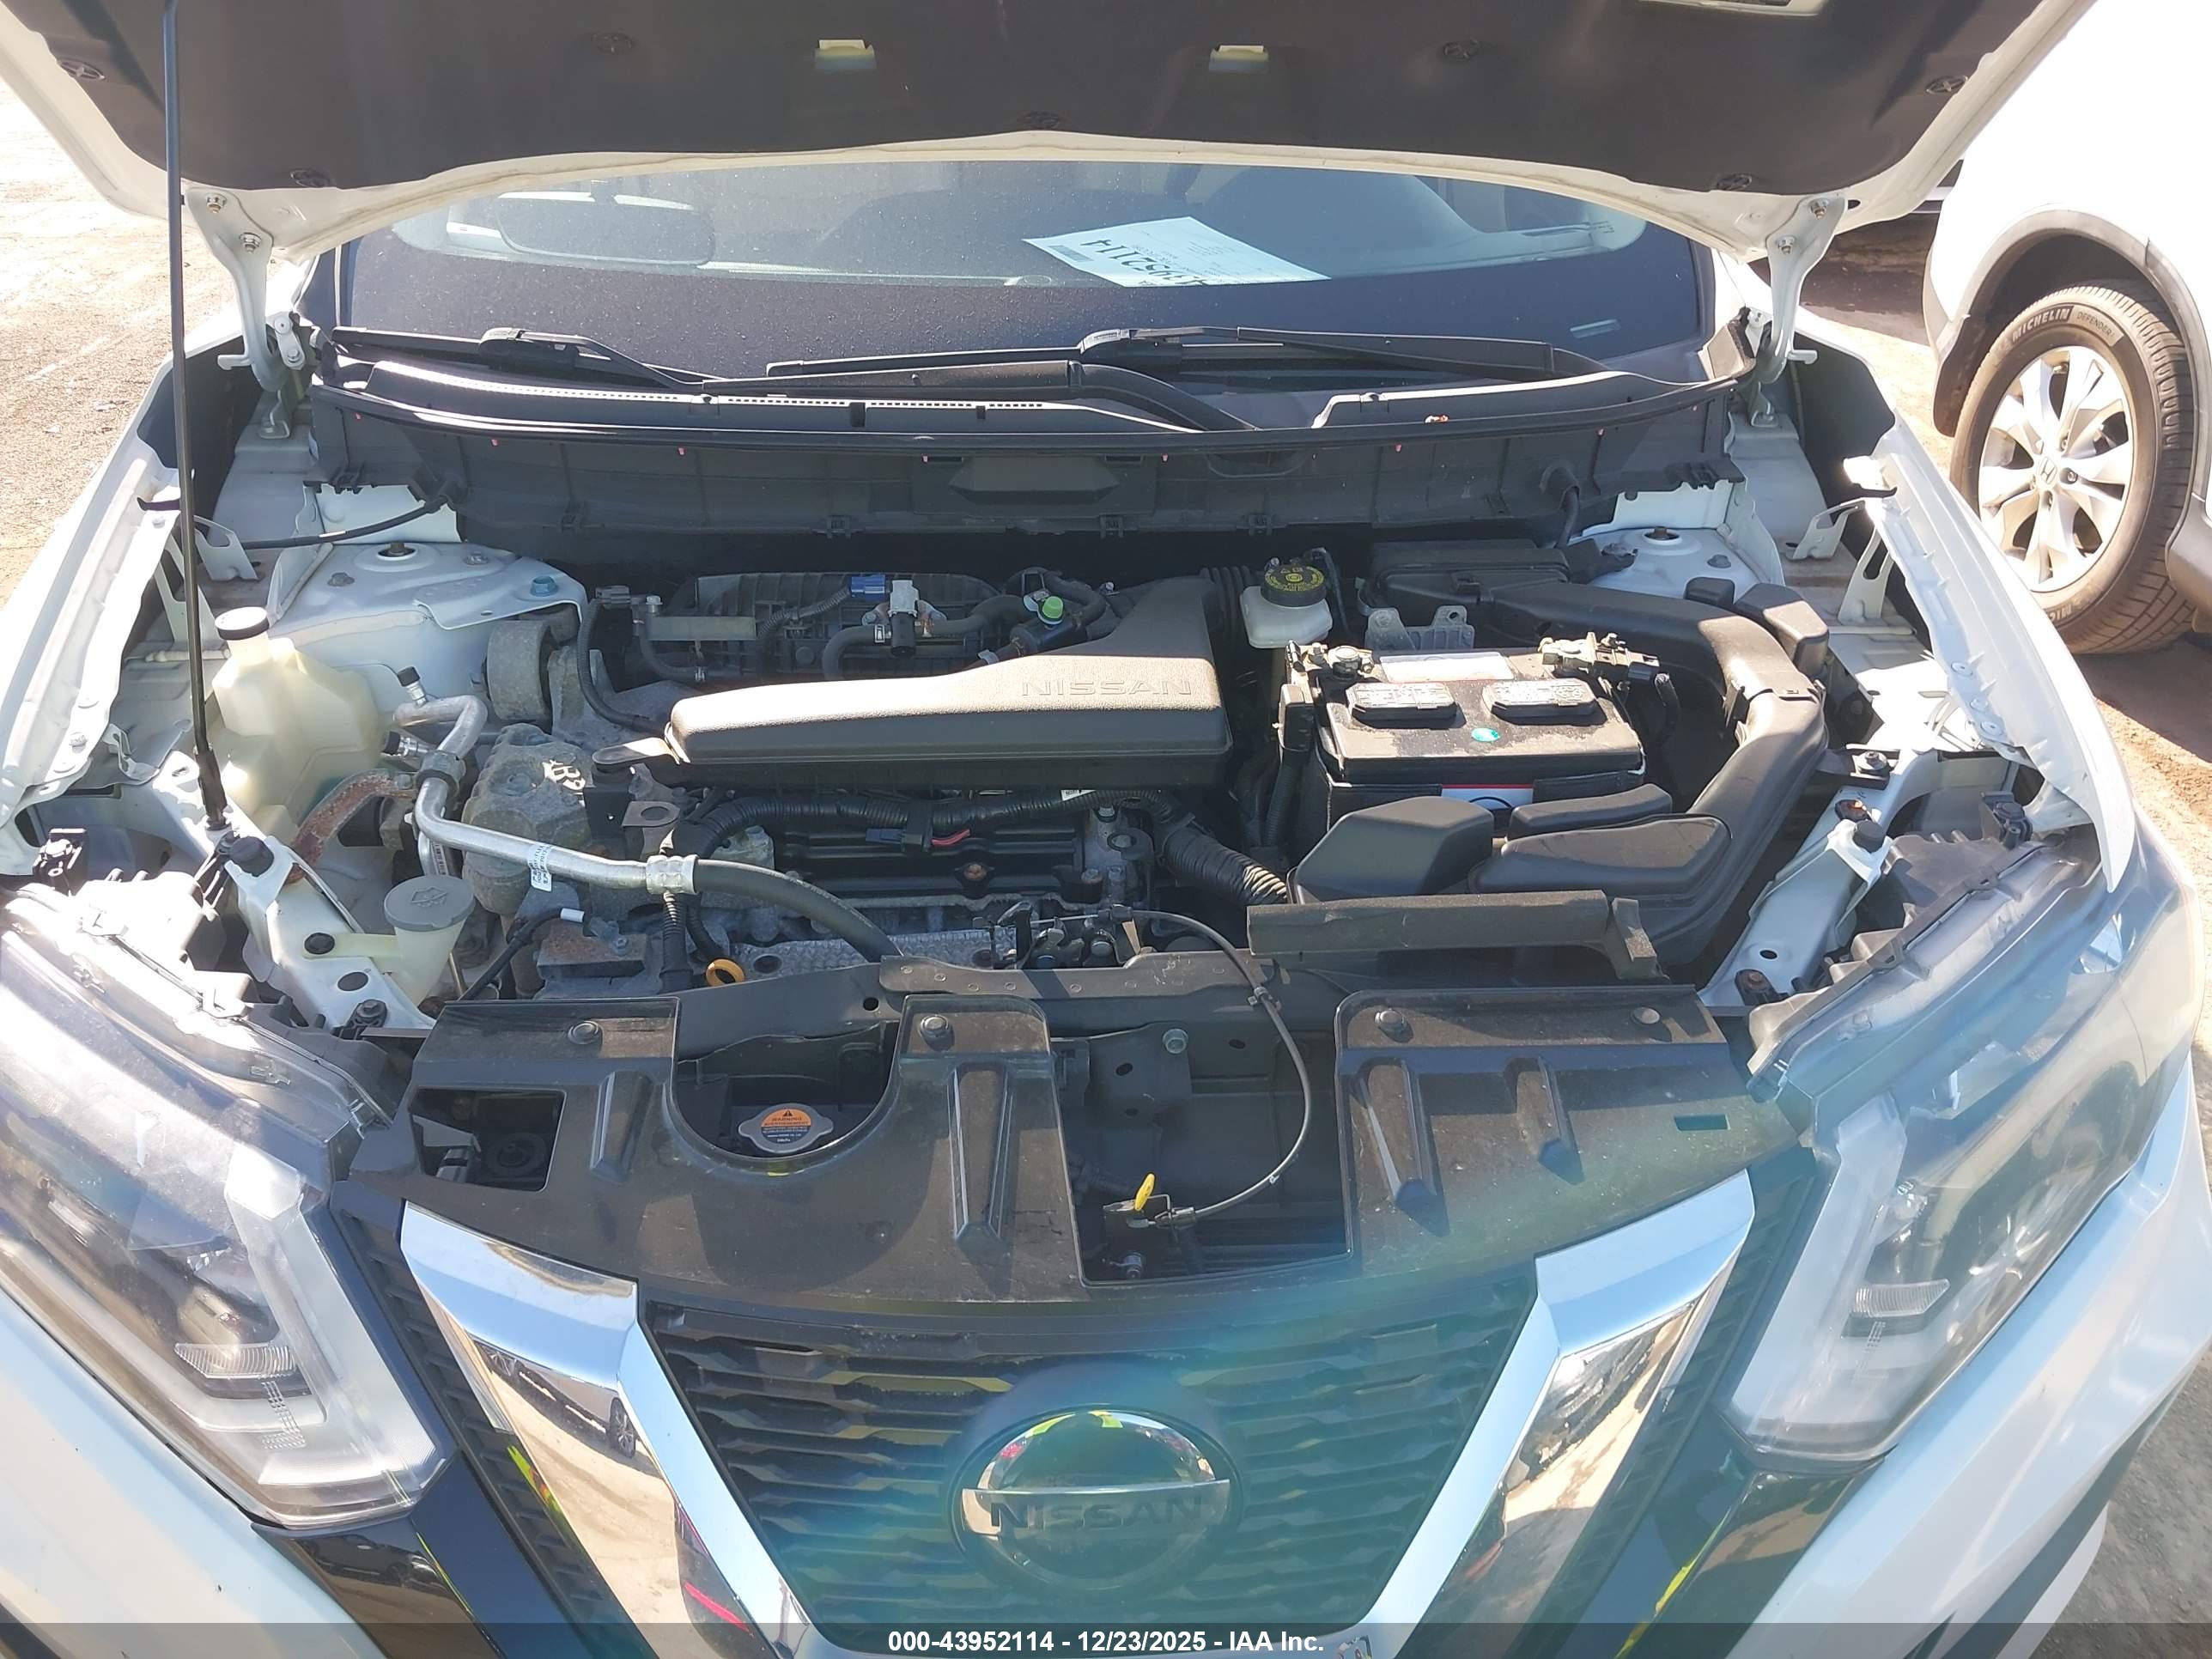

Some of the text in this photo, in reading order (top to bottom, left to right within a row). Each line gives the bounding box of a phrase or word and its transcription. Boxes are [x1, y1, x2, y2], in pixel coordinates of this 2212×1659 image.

[2011, 308, 2070, 343] MICHELIN
[1021, 679, 1193, 696] NISSAN
[990, 1496, 1202, 1531] NISSAN
